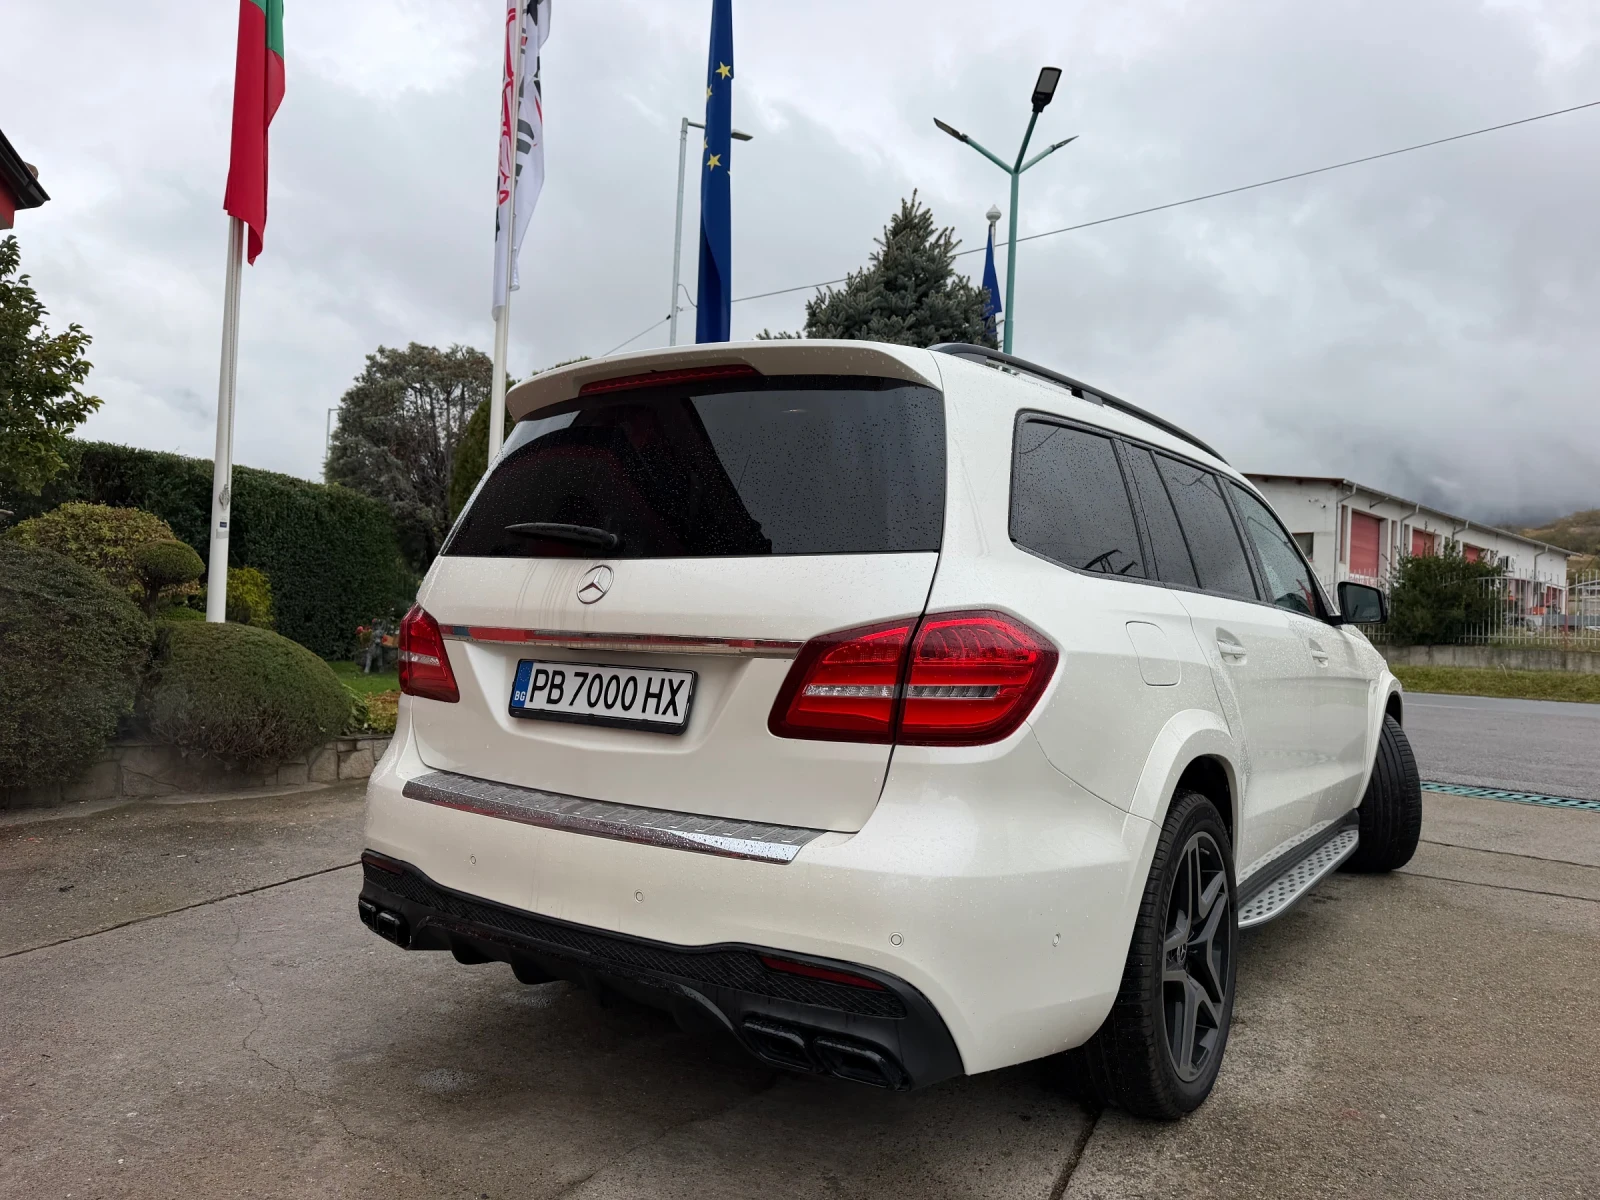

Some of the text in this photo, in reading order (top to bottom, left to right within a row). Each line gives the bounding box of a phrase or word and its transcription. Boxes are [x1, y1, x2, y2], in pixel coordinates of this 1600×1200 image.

[514, 690, 526, 701] BG
[529, 669, 686, 717] PB 7000 HX
